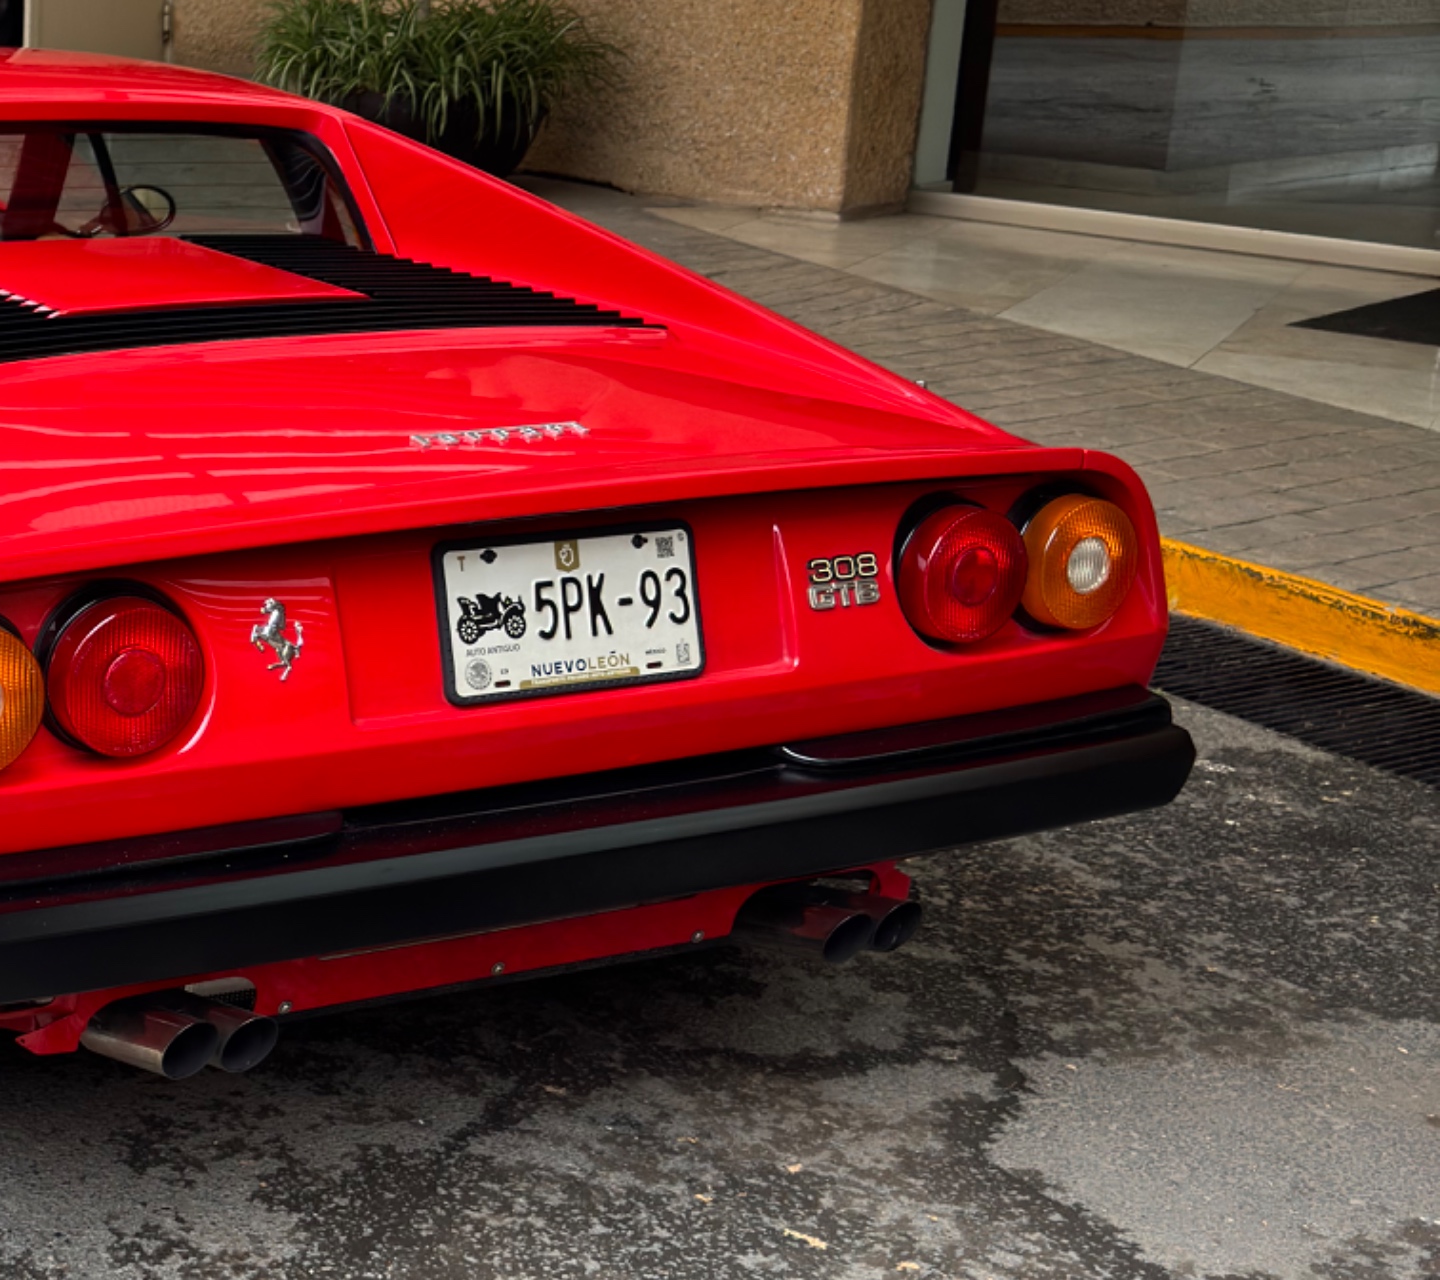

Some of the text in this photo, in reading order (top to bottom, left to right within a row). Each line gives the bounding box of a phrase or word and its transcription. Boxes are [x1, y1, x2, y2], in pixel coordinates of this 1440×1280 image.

[807, 552, 879, 584] 308
[534, 567, 690, 640] 5PK-93
[807, 578, 880, 610] GTB
